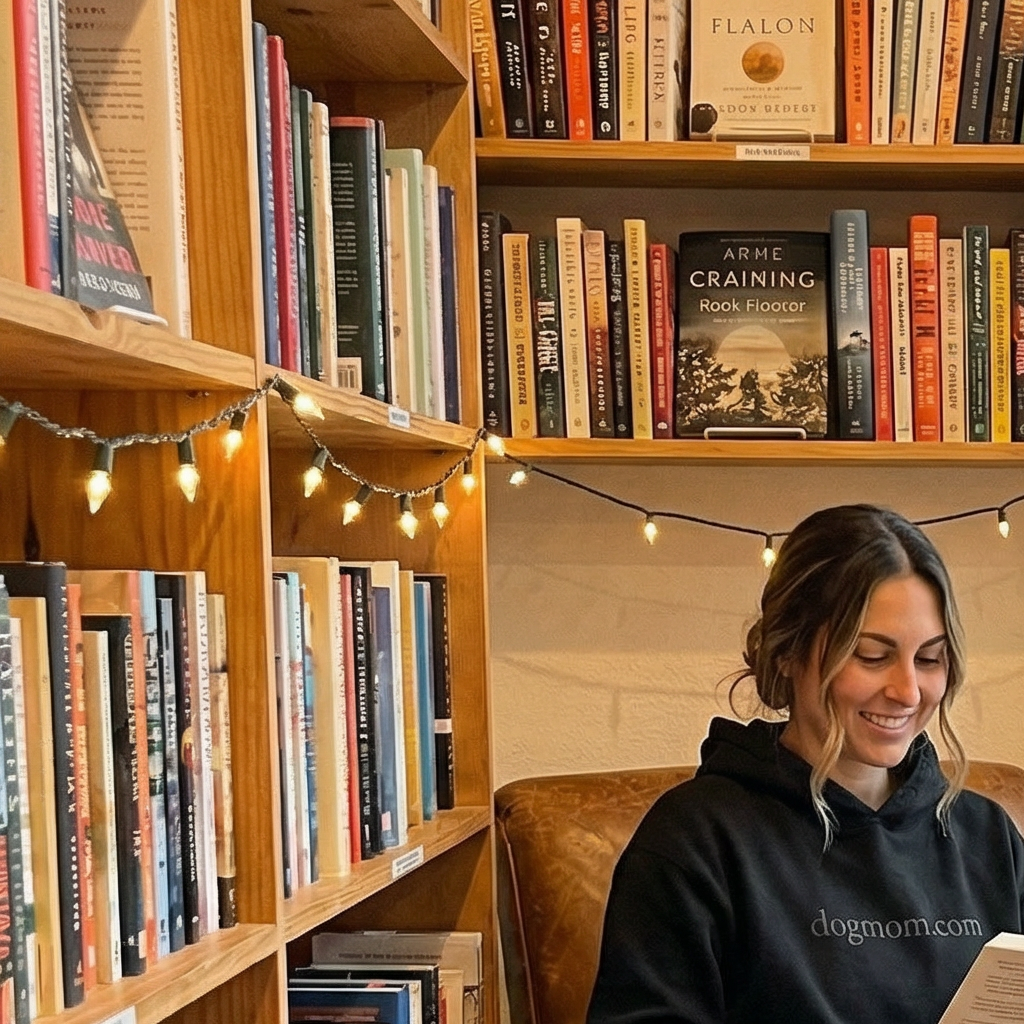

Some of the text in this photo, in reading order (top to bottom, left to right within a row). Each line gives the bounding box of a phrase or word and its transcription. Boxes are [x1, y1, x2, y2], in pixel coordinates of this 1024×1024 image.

[712, 17, 814, 34] FLALON
[723, 247, 782, 260] ARME
[689, 270, 815, 288] CRAINING
[700, 298, 740, 312] Rook
[811, 908, 983, 946] dogmom.com
